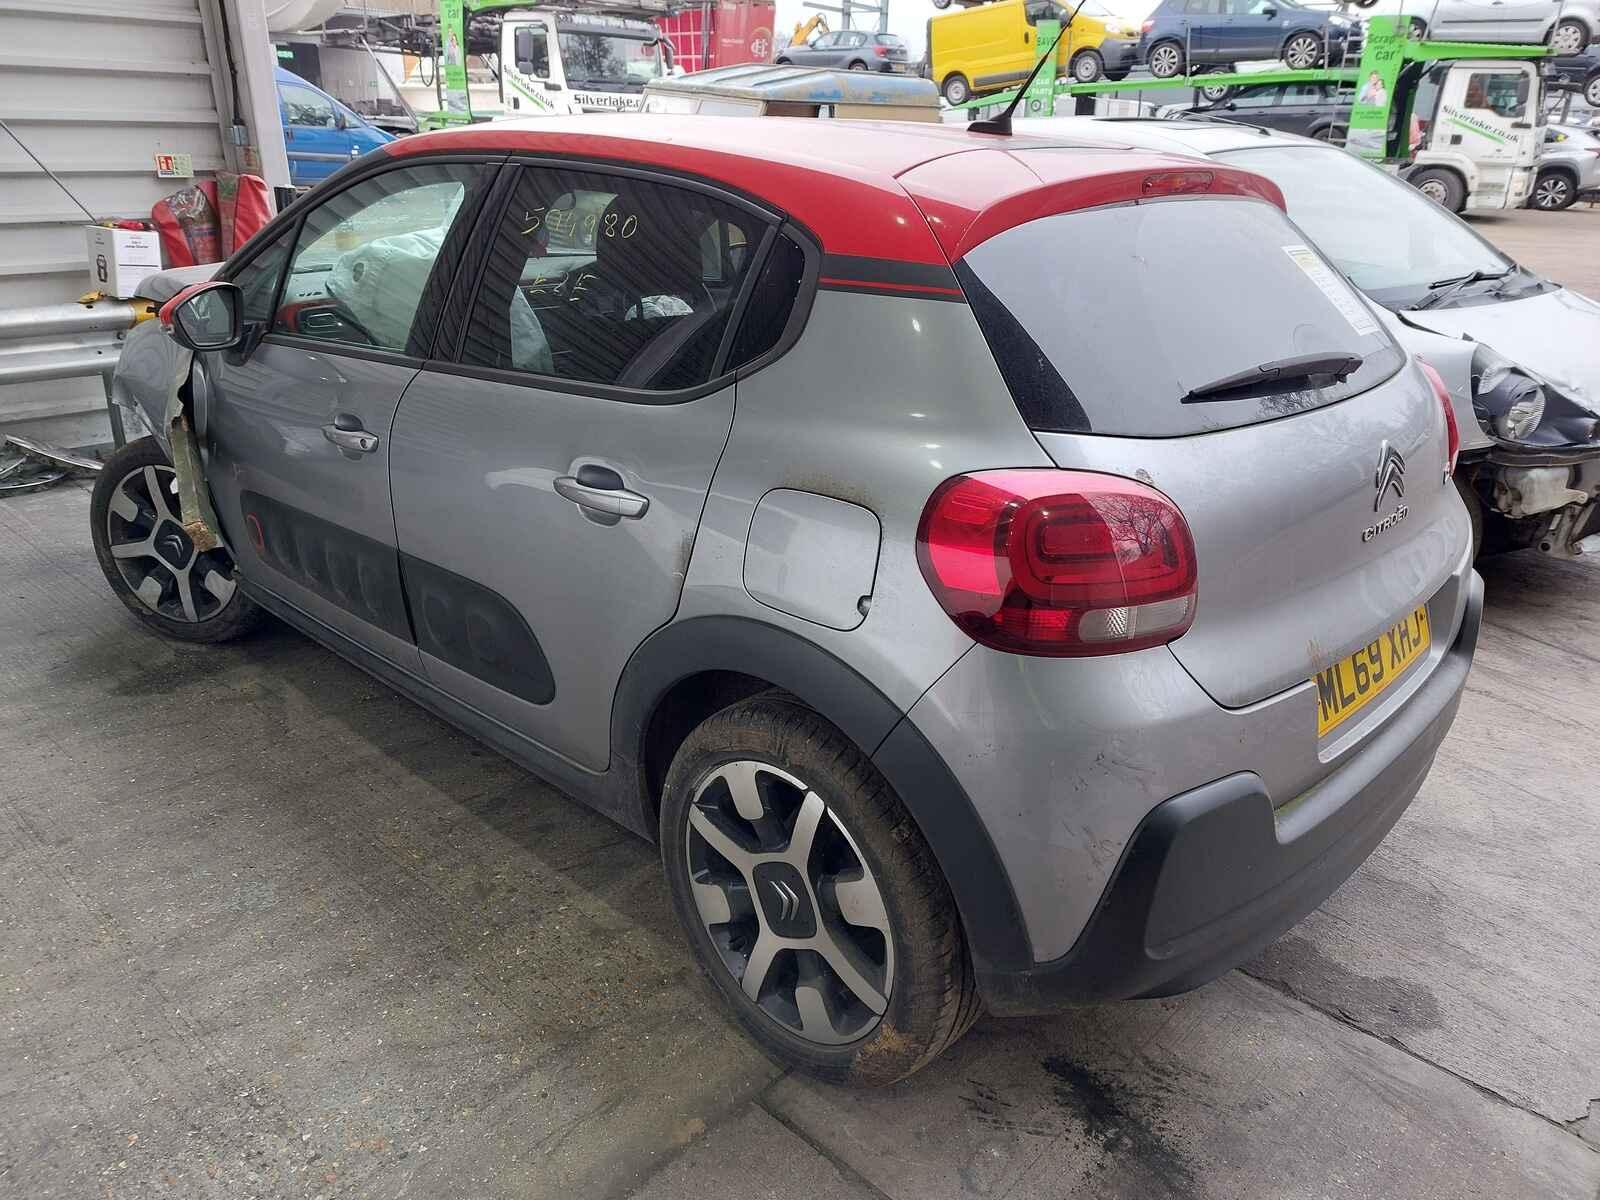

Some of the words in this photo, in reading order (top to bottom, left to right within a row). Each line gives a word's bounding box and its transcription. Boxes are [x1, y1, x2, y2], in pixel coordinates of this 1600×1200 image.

[1442, 104, 1520, 143] Silverlake.co.uk
[1316, 638, 1385, 722] ML69
[1387, 609, 1422, 670] XHJ
